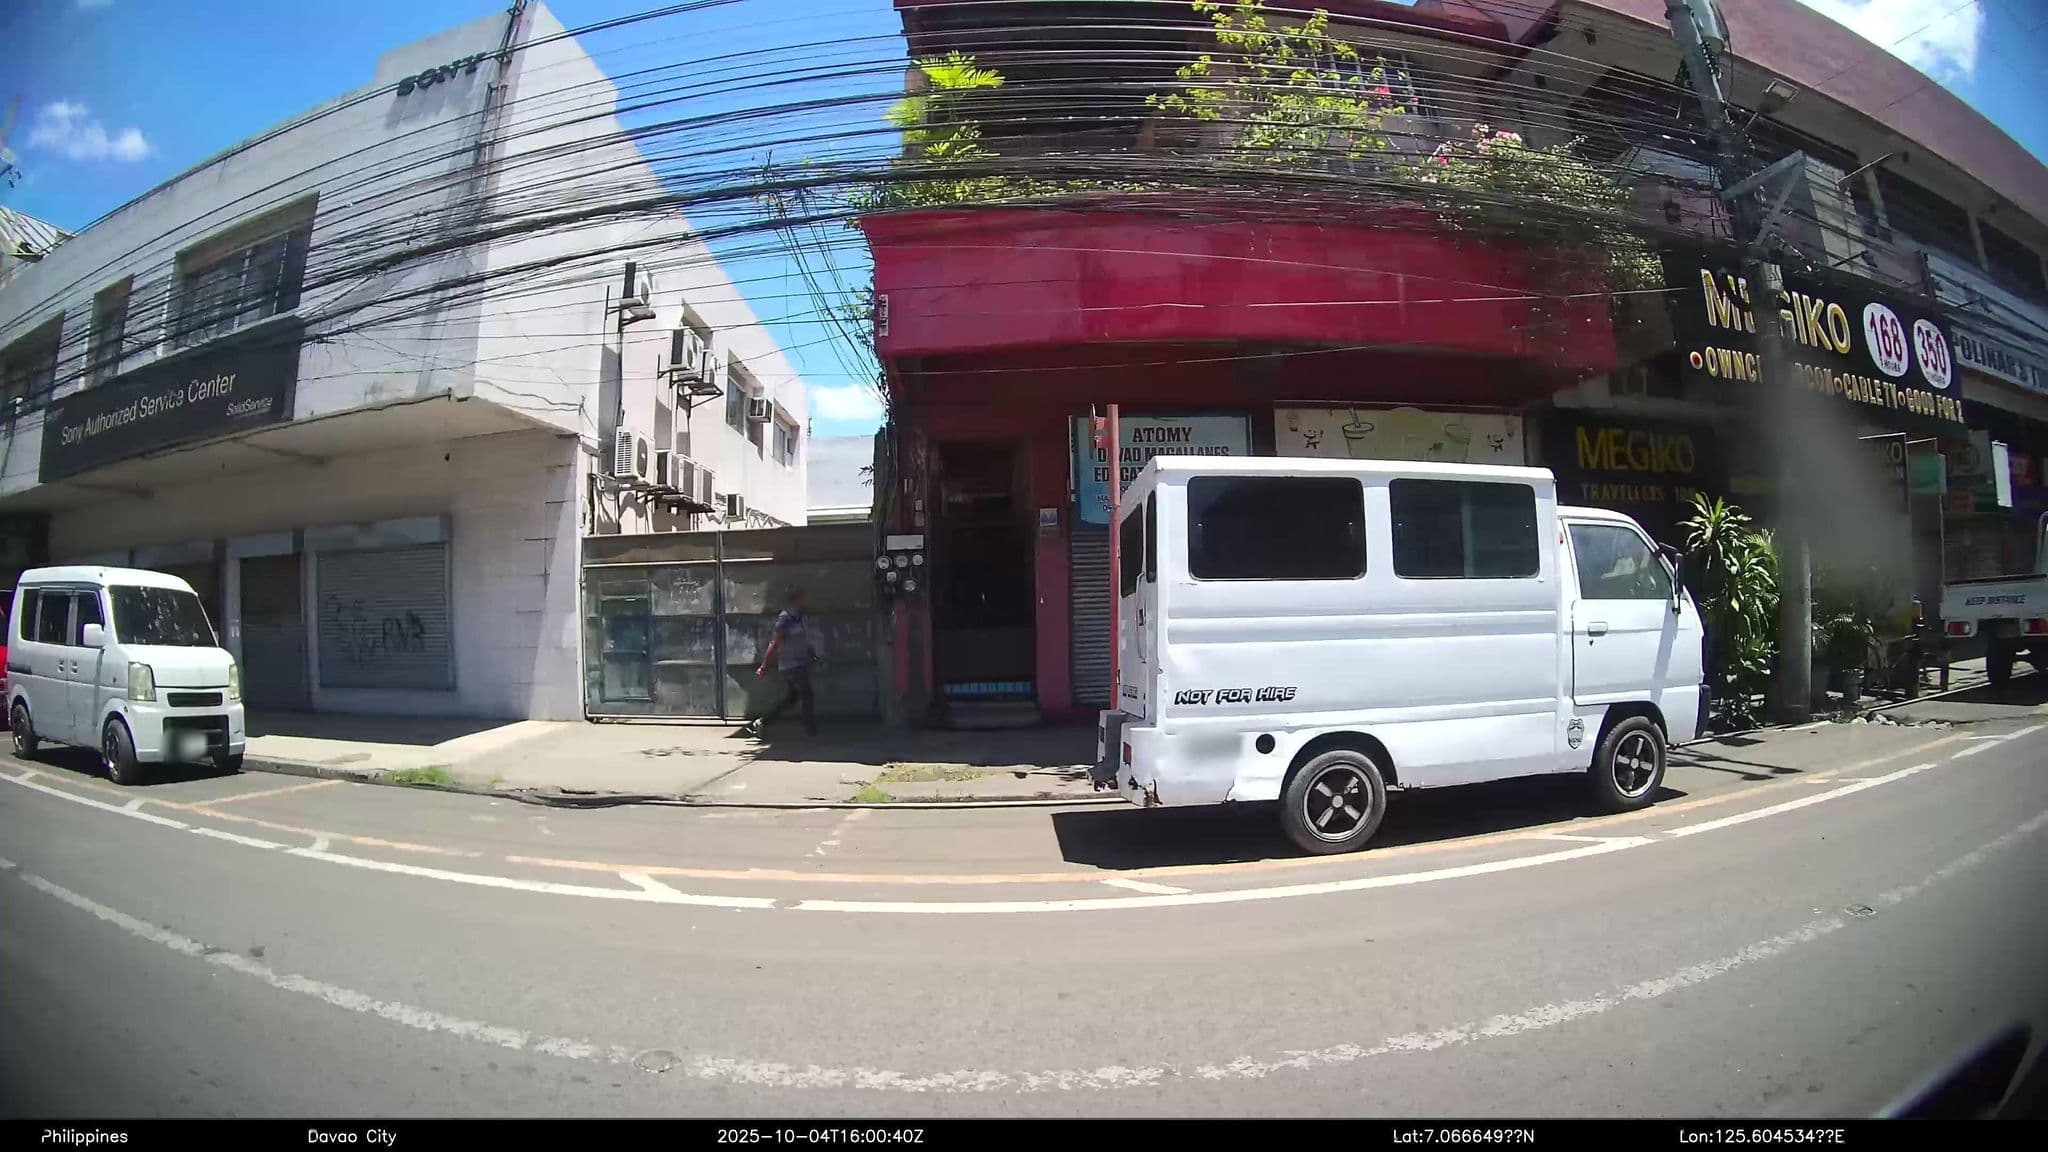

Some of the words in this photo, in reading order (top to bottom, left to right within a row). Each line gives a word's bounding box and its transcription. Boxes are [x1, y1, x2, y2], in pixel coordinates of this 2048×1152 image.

[1870, 312, 1902, 362] 168
[1918, 326, 1947, 377] 350
[61, 425, 84, 446] Sony
[84, 400, 137, 438] Authorized
[139, 389, 184, 419] Service
[188, 373, 237, 403] Center
[1843, 373, 1884, 406] CABLE
[1883, 382, 1898, 409] TV
[1906, 388, 1936, 417] GOOD
[1936, 395, 1957, 422] FOR
[1956, 400, 1965, 424] 2
[1132, 426, 1193, 443] ATOMY
[1576, 425, 1696, 473] MEGIKO
[1175, 689, 1213, 705] NOT
[1216, 688, 1252, 704] FOR
[1255, 686, 1297, 702] HIRE
